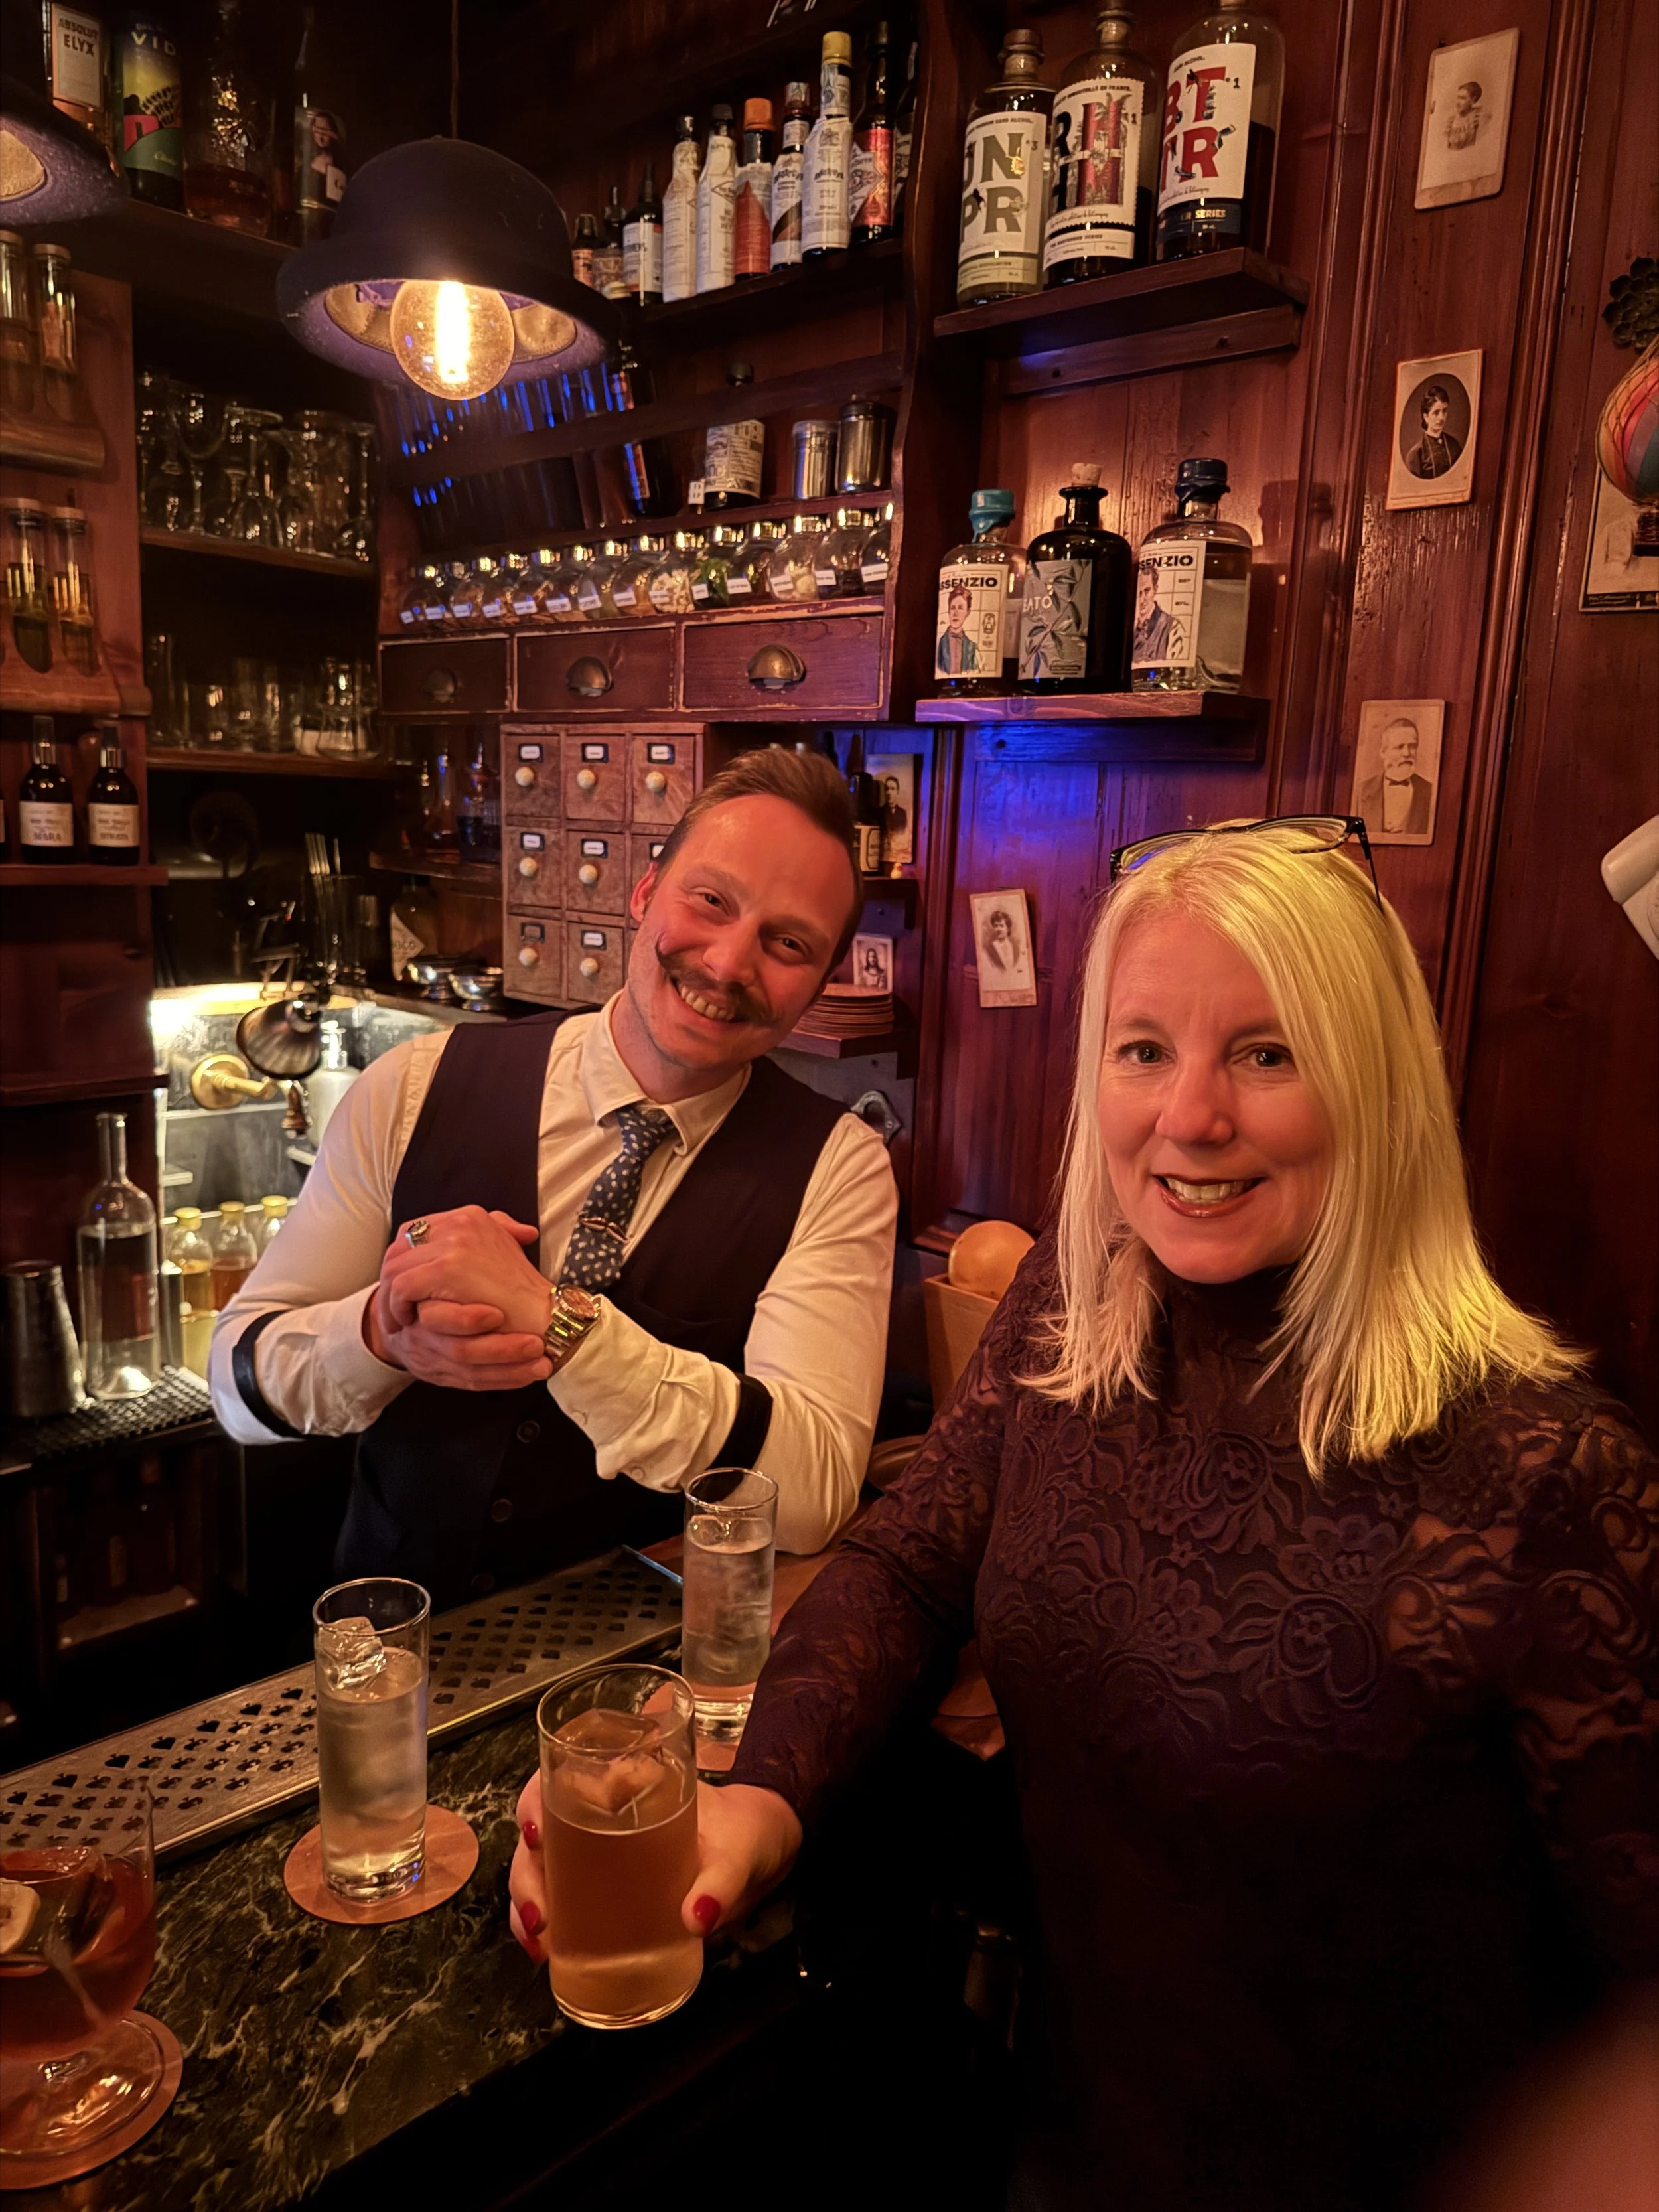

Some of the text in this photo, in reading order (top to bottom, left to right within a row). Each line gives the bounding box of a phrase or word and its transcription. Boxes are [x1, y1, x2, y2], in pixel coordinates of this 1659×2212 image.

[58, 18, 98, 40] ABSOLUT
[64, 35, 95, 57] ELYX
[1195, 209, 1226, 219] SERIES
